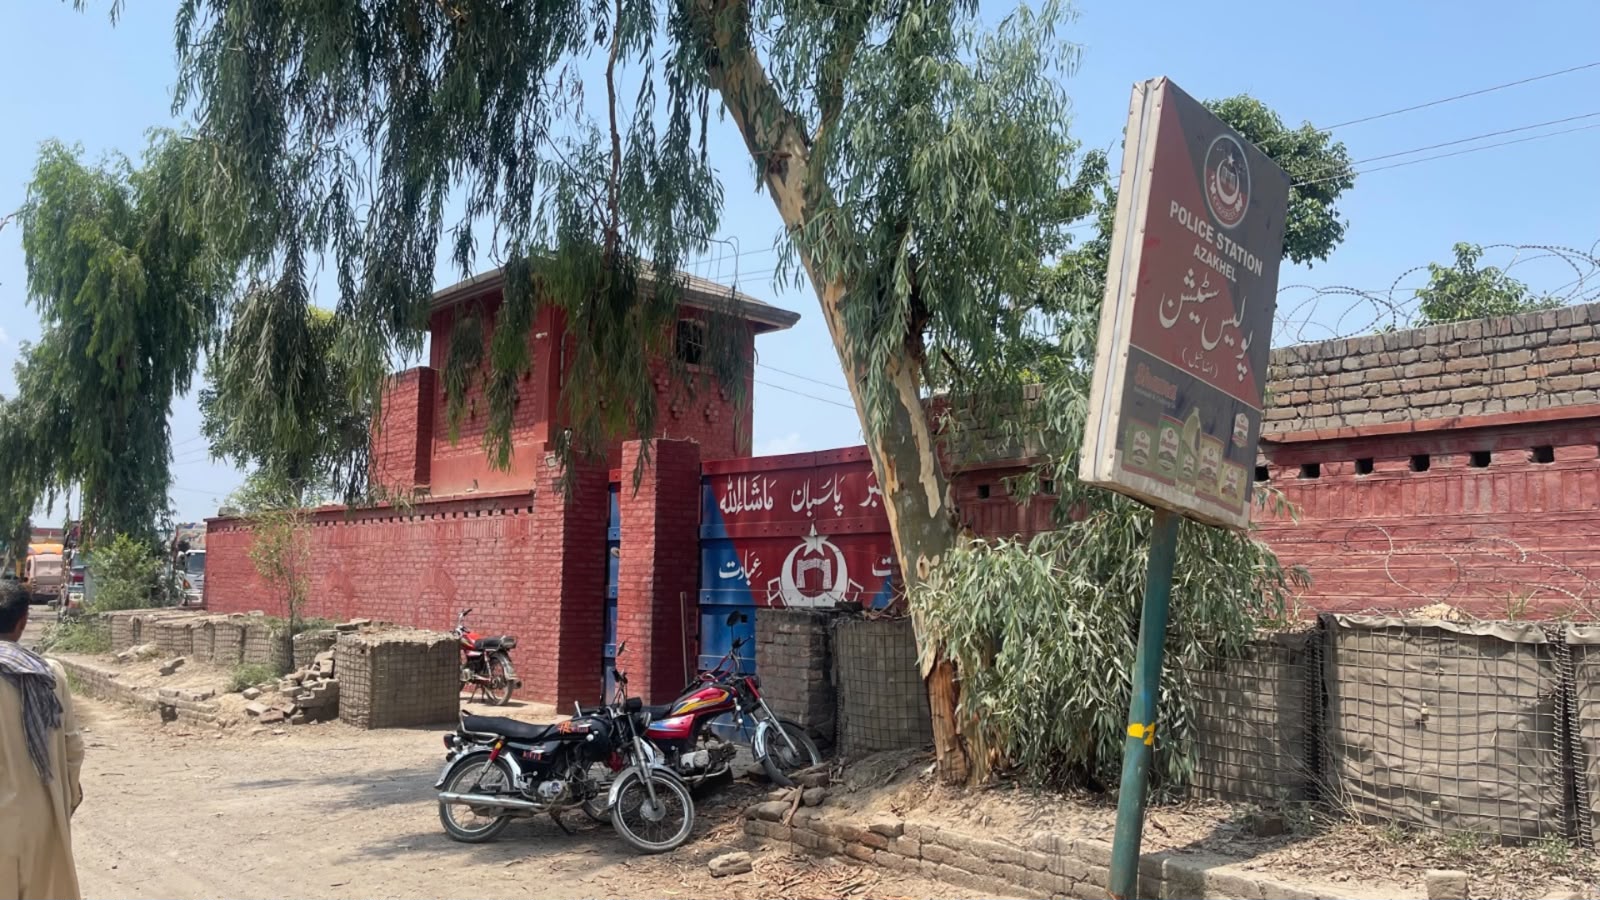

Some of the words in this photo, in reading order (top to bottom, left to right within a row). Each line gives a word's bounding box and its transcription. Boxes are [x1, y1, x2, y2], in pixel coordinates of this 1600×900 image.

[1169, 200, 1214, 244] POLICE
[1216, 232, 1263, 277] STATION
[1193, 244, 1237, 282] AZAKHEL
[1159, 268, 1220, 329] سٹیشن
[1201, 296, 1253, 382] پولیس
